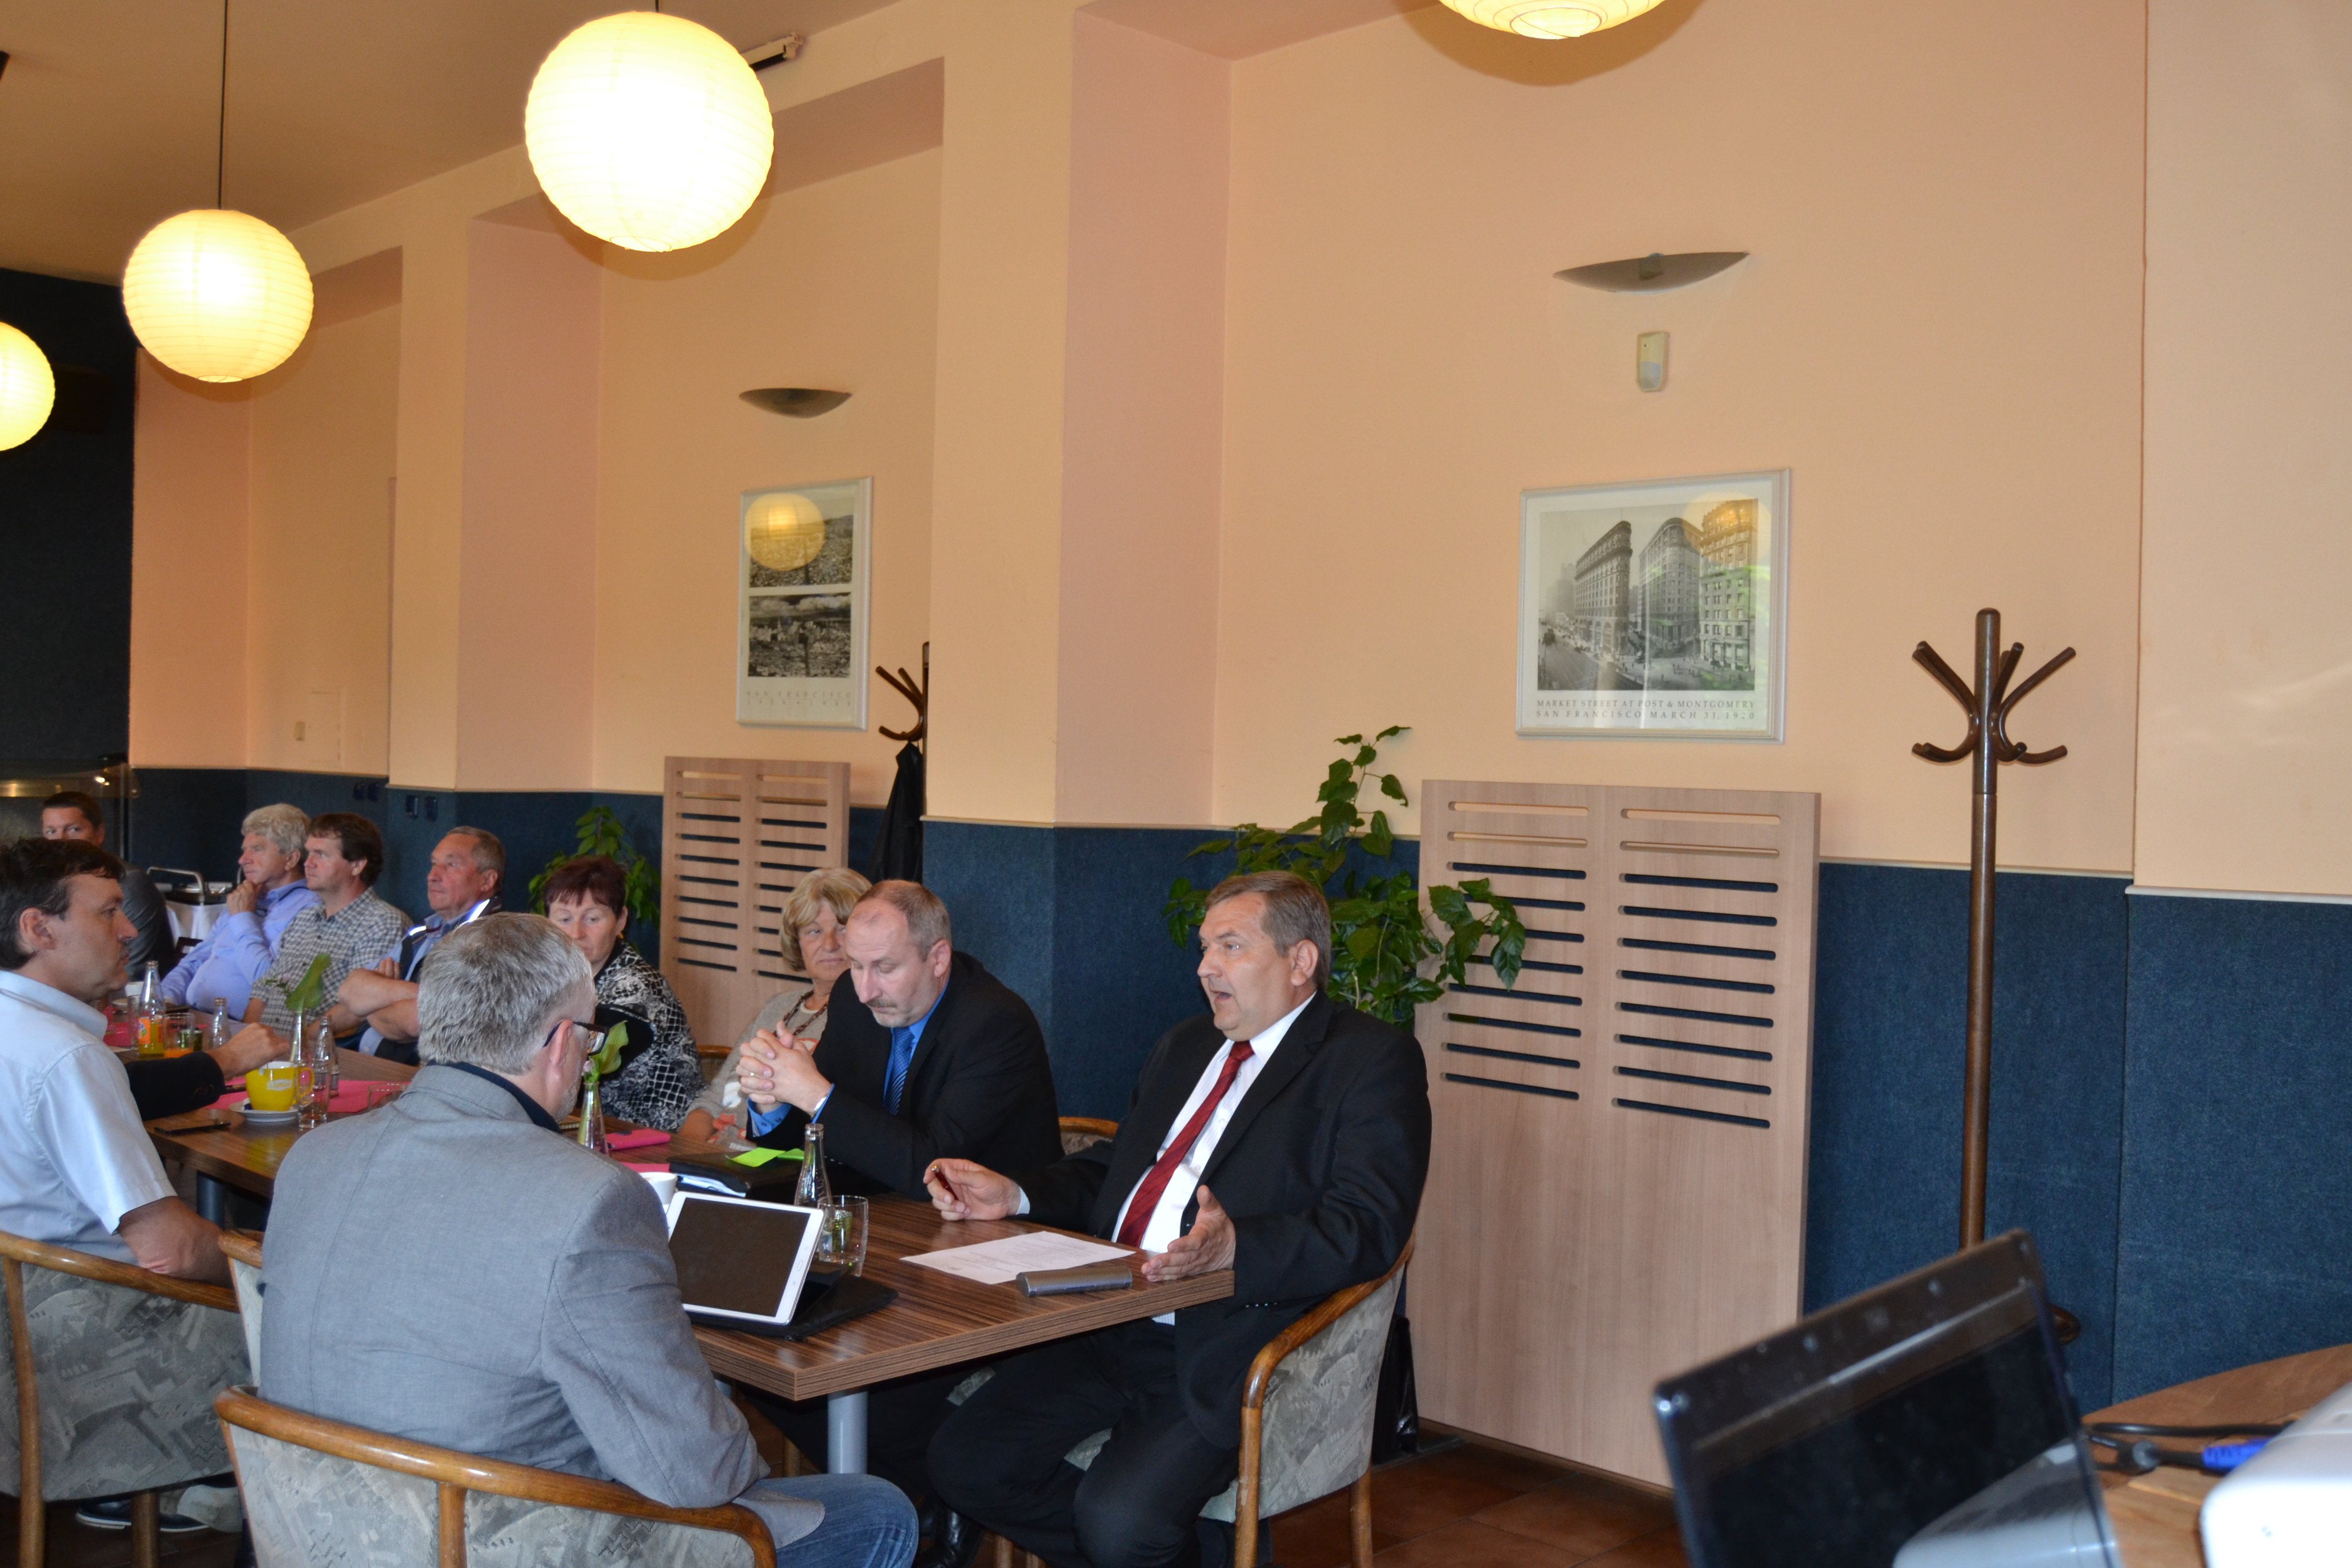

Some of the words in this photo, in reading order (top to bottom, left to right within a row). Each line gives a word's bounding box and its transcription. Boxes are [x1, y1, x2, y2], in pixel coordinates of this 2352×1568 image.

[1536, 699, 1577, 707] MARKET
[1621, 700, 1635, 708] AT
[1637, 700, 1664, 708] POST
[1667, 700, 1674, 708] &
[1677, 700, 1755, 708] MONTGOMERY
[1566, 710, 1641, 719] FRANCISCO
[1650, 711, 1697, 719] MARCH
[1704, 712, 1720, 720] 31,
[1726, 712, 1755, 720] 1920
